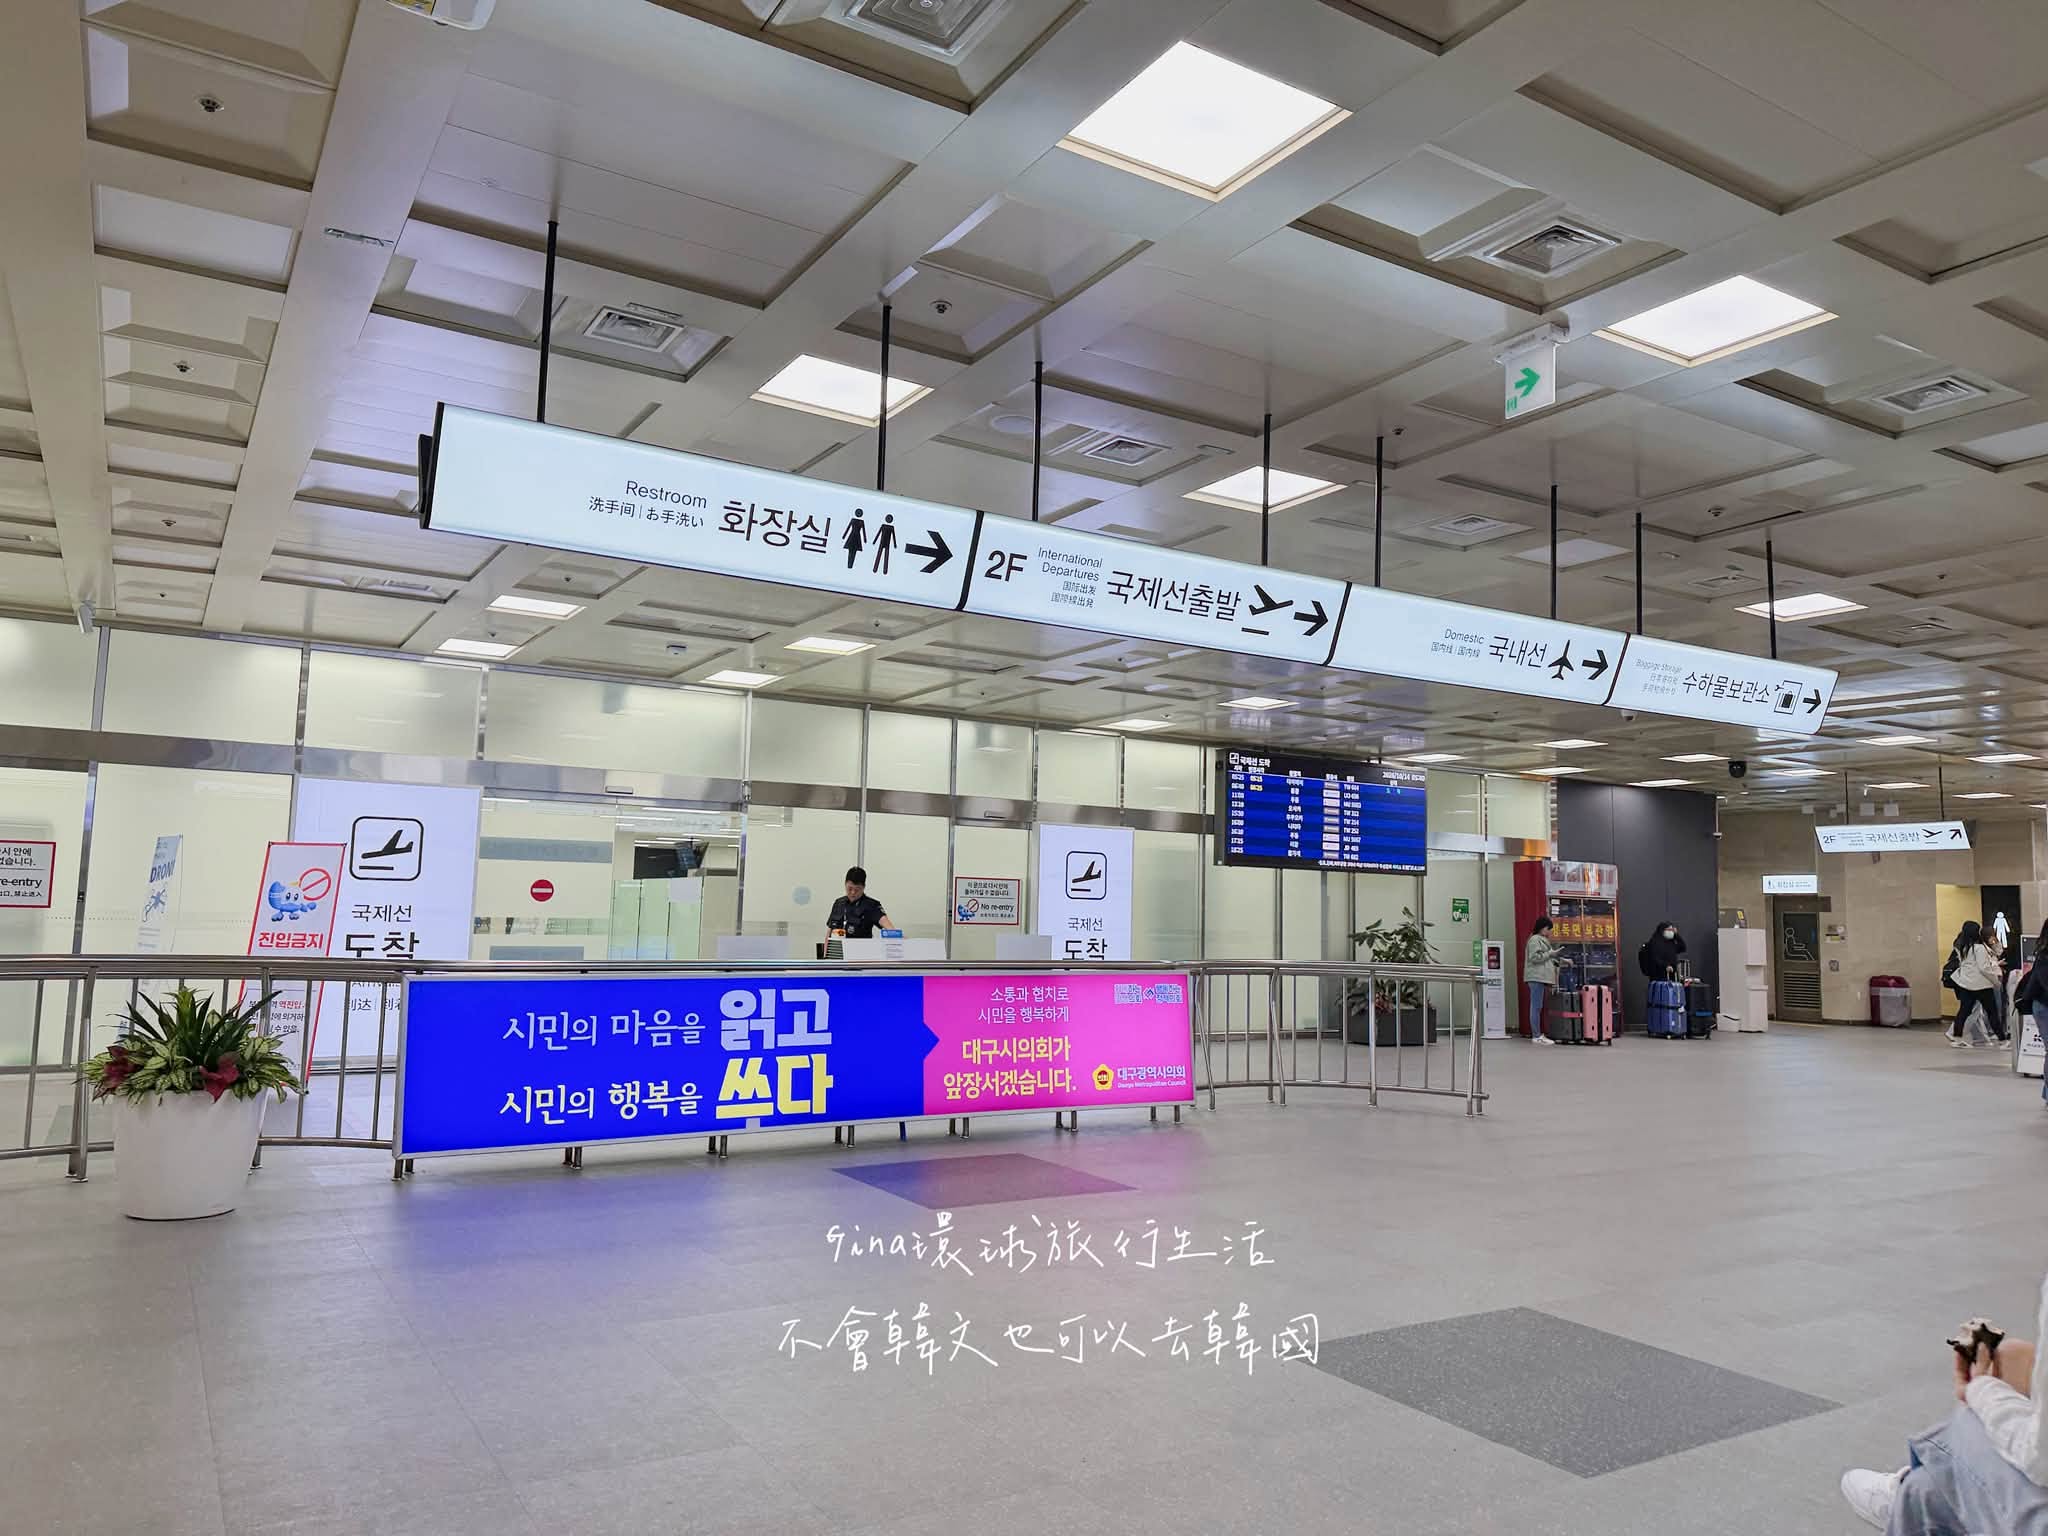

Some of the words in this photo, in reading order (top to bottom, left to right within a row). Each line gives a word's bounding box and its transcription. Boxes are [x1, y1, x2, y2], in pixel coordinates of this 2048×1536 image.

[626, 481, 707, 508] Restroom
[589, 496, 635, 518] 洗手间
[646, 508, 704, 528] お手洗い
[718, 500, 831, 554] 화장실
[985, 550, 1028, 583] 2F
[1038, 547, 1103, 568] International
[1042, 562, 1100, 582] Departures
[1107, 570, 1241, 622] 국제선출발
[1444, 628, 1485, 644] Domestic
[1489, 636, 1547, 668] 국내선
[1683, 671, 1770, 703] 수하물보관소
[1823, 835, 1837, 844] 2F
[13, 847, 32, 857] 안에
[352, 904, 413, 922] 국제선
[991, 904, 1014, 912] re-entry
[1067, 917, 1103, 932] 국제선
[258, 931, 324, 949] 진입금지
[345, 931, 420, 960] 도착
[1062, 938, 1107, 960] 도착
[991, 986, 1029, 1003] 소통과
[1032, 986, 1070, 1002] 협치로
[502, 1011, 598, 1051] 시민의
[610, 1009, 706, 1048] 마음을
[719, 988, 833, 1051] 읽고
[978, 1007, 1017, 1024] 시민을
[1019, 1006, 1070, 1024] 행복하게
[962, 1036, 1072, 1065] 대구시의회가
[943, 1067, 1077, 1100] 앞장서겠습니다.
[1117, 1065, 1186, 1081] 대구광역시의회
[500, 1085, 595, 1125] 시민의
[608, 1080, 703, 1120] 행복을
[715, 1053, 834, 1120] 쓰다
